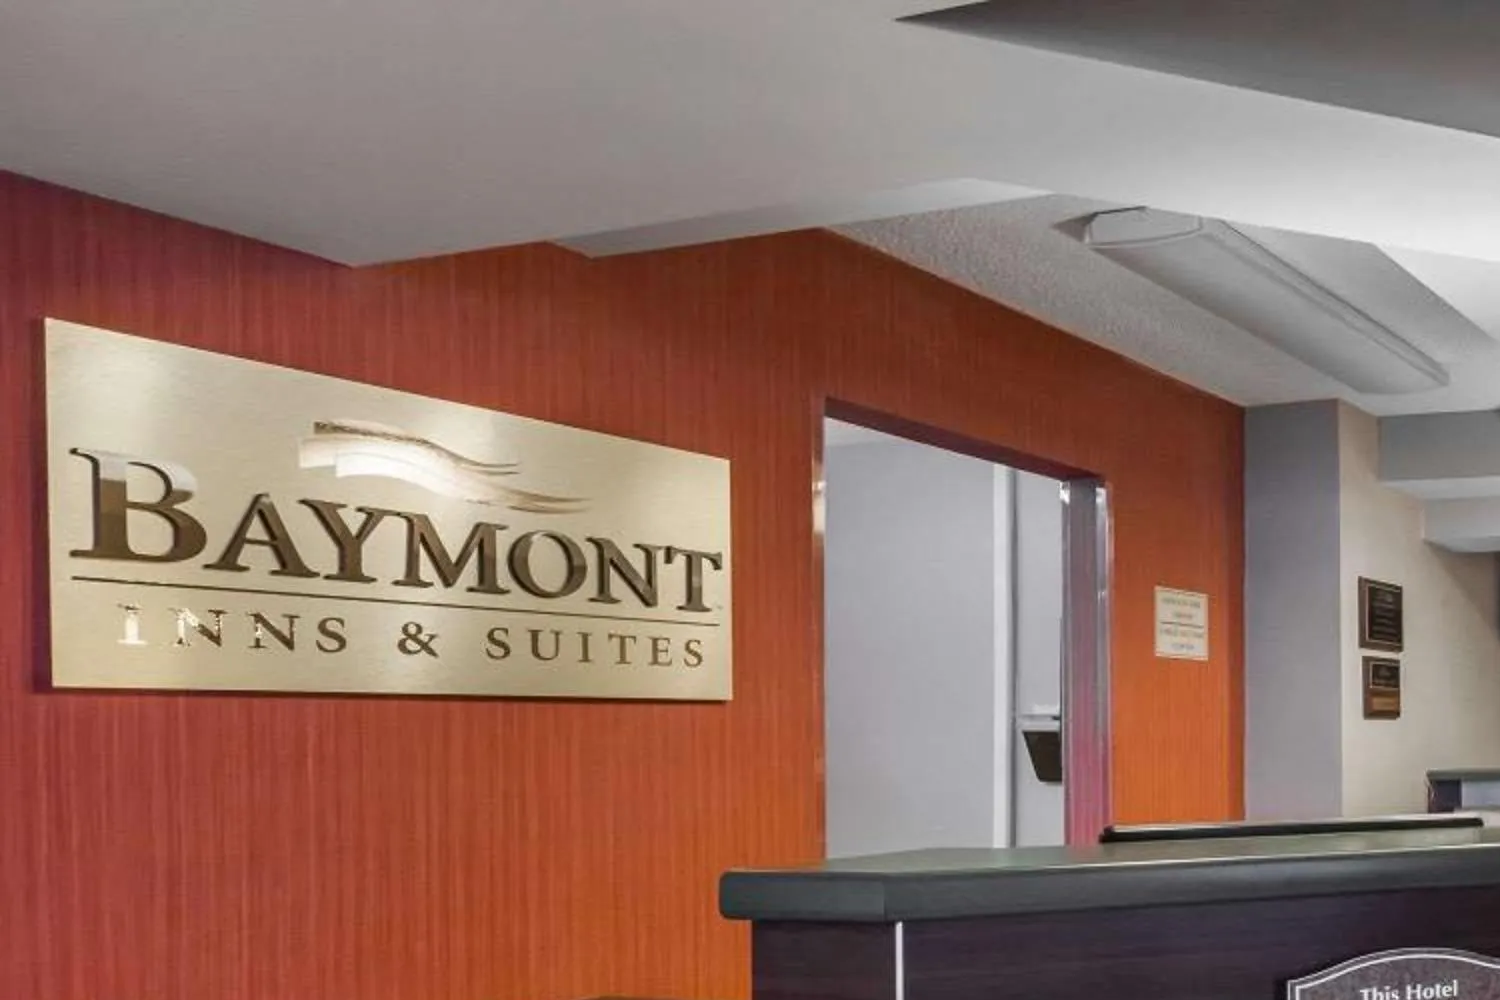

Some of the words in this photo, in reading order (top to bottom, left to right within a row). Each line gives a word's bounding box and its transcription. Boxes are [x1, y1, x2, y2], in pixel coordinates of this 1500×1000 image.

[69, 447, 723, 612] BAYMONT
[117, 603, 347, 653] INNS
[397, 620, 439, 658] &
[486, 627, 706, 668] SUITES
[1406, 980, 1459, 1000] Hotel
